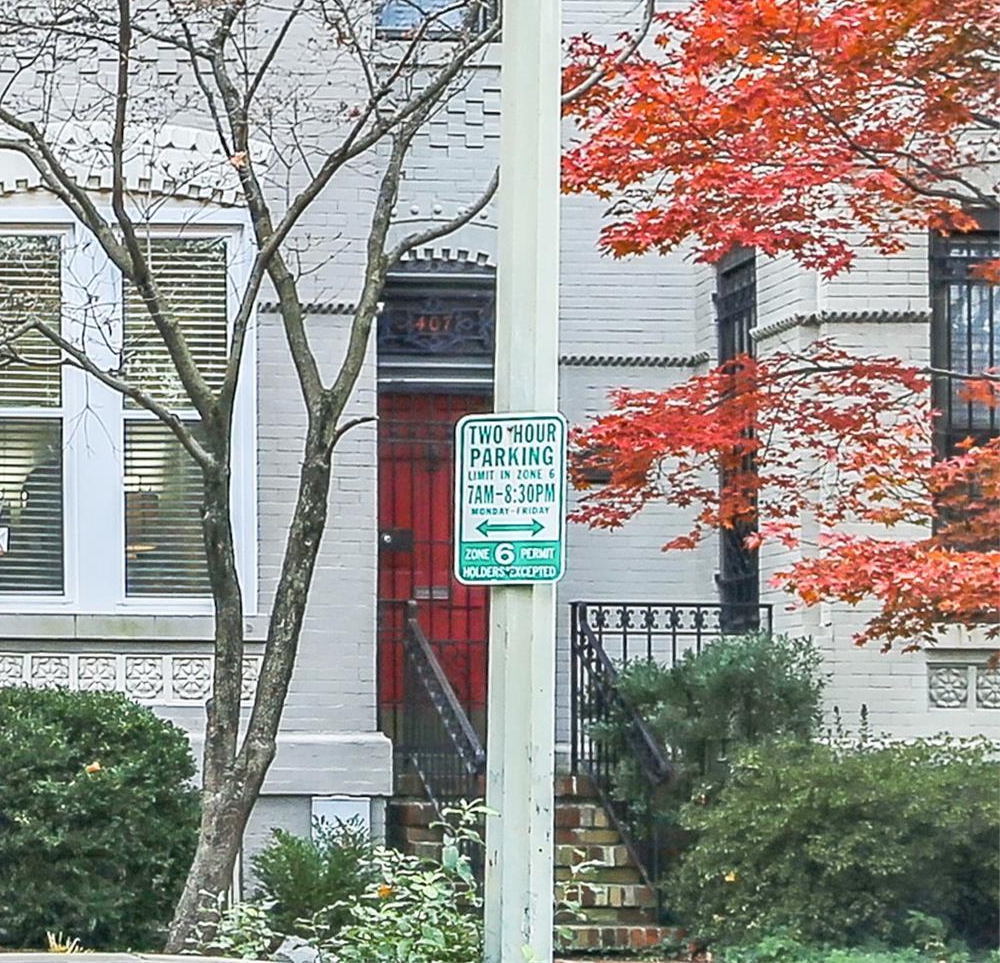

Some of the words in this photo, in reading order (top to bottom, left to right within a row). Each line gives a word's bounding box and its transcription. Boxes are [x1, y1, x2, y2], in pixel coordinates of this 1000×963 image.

[416, 316, 451, 332] 407
[469, 425, 502, 444] TWO
[513, 423, 556, 443] HOUR
[470, 446, 553, 467] PARKING
[468, 470, 494, 481] LIMIT
[500, 470, 511, 479] IN
[517, 469, 542, 479] ZONE
[549, 469, 555, 479] 6
[468, 483, 555, 504] 7AM-8:30PM
[465, 548, 490, 560] ZONE
[495, 542, 516, 566] 6
[520, 548, 555, 559] PERMIT
[463, 566, 504, 578] HOLDERS
[509, 566, 556, 577] EXCEPTED
